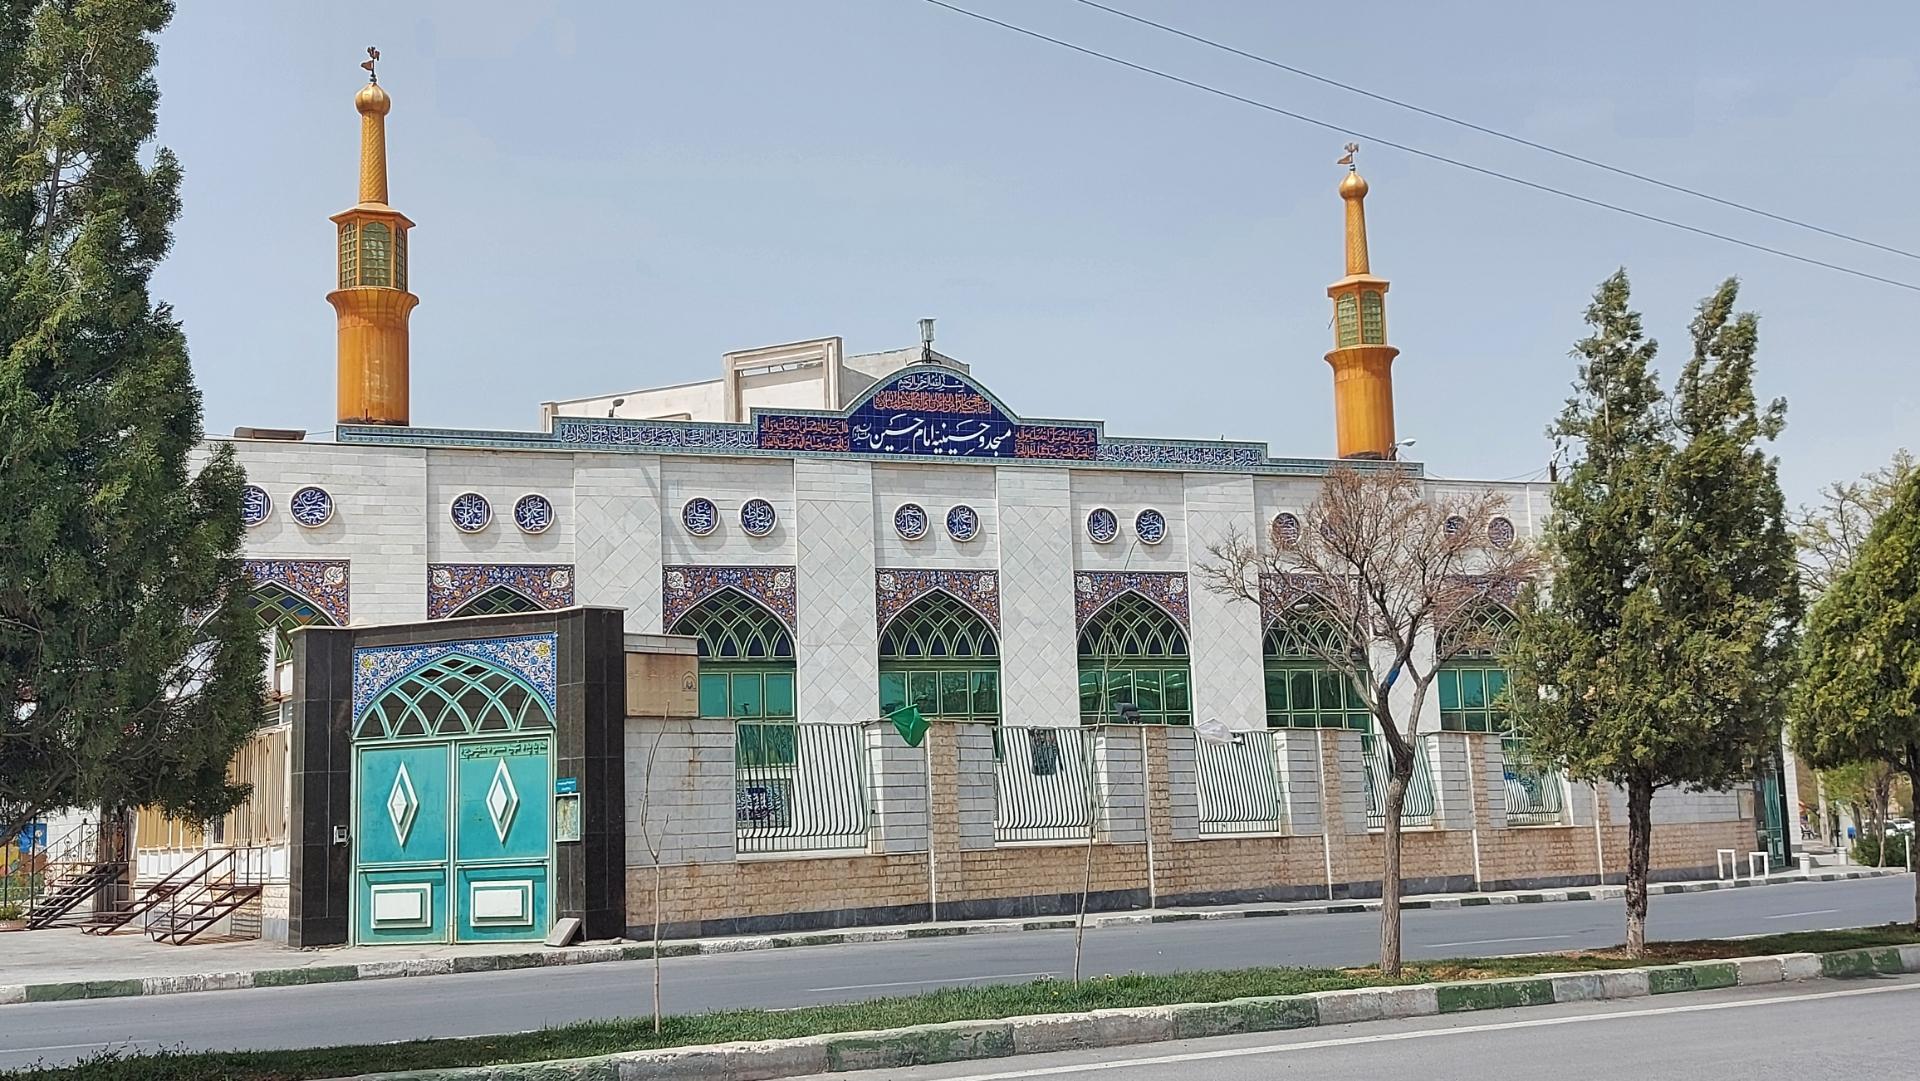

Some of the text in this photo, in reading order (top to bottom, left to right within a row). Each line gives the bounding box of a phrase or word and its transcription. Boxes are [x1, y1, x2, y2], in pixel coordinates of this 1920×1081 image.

[869, 413, 925, 453] حسین
[912, 423, 934, 454] امام
[931, 420, 991, 455] حسینیه
[977, 435, 985, 448] و
[984, 428, 1012, 457] مسجد
